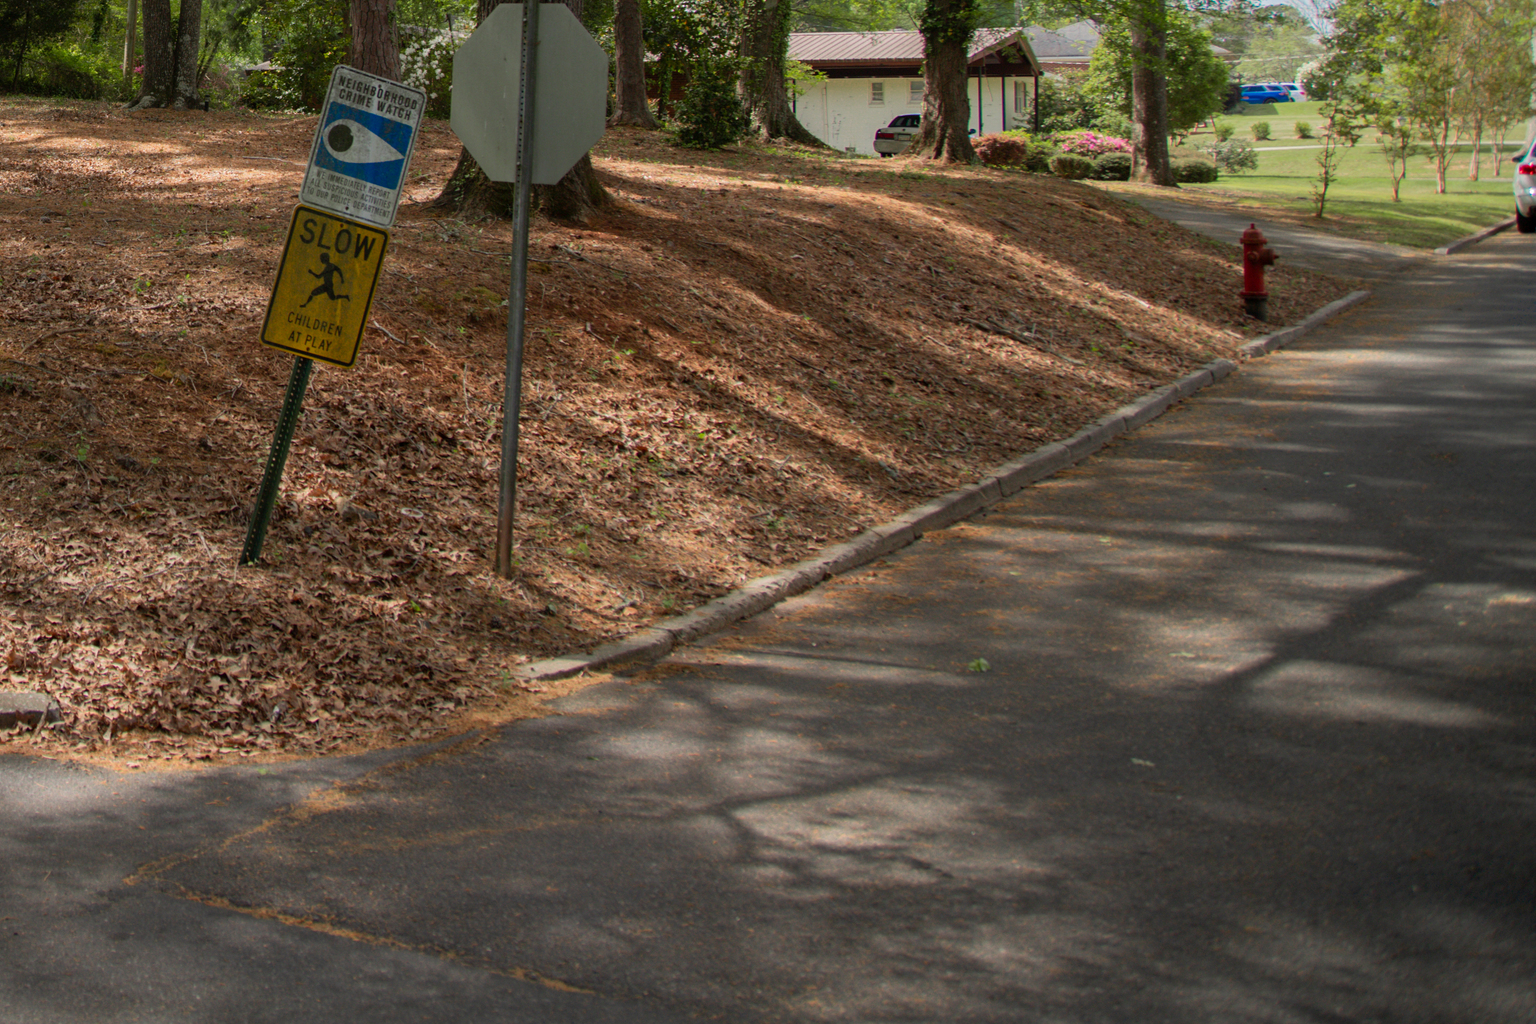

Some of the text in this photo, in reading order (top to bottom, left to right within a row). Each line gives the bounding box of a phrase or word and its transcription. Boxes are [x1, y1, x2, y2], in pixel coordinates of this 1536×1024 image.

[338, 75, 418, 110] NEIGHBORHOOD
[339, 88, 412, 121] CRIME WATCH
[310, 178, 392, 209] ALL SUSPICIOUS ACTIVITIES
[316, 169, 391, 200] WE IMMEDIATELY REPORT
[306, 186, 391, 218] TO OUR POLICE DEPARTMENT
[299, 218, 376, 261] SLOW
[287, 311, 343, 337] CHILDREN
[288, 330, 333, 352] AT PLAY
